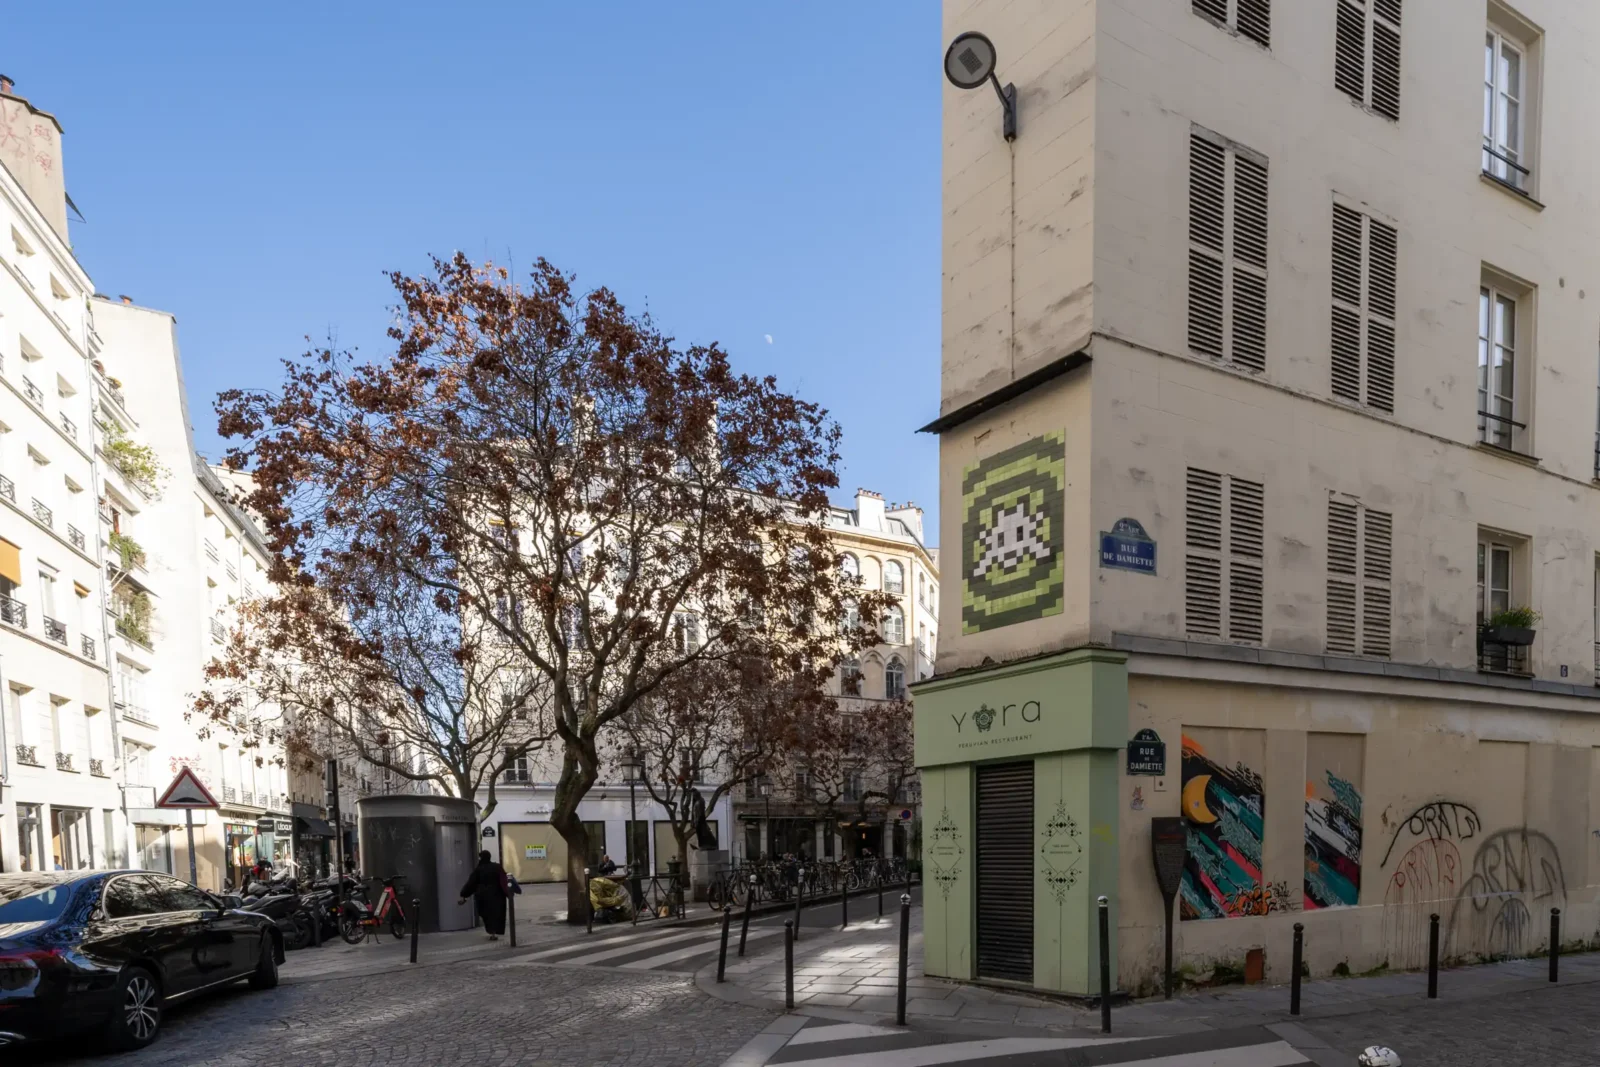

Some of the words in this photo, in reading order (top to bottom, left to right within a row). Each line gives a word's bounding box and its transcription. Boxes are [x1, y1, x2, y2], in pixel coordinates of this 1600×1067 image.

[1120, 543, 1138, 554] RUE
[1103, 552, 1114, 561] DE
[1116, 554, 1154, 567] DAMIETTE
[958, 740, 989, 749] PERUVIAN
[991, 734, 1033, 745] RESTAURANT
[1139, 747, 1155, 756] RUE
[1130, 762, 1163, 771] DAMIETTE
